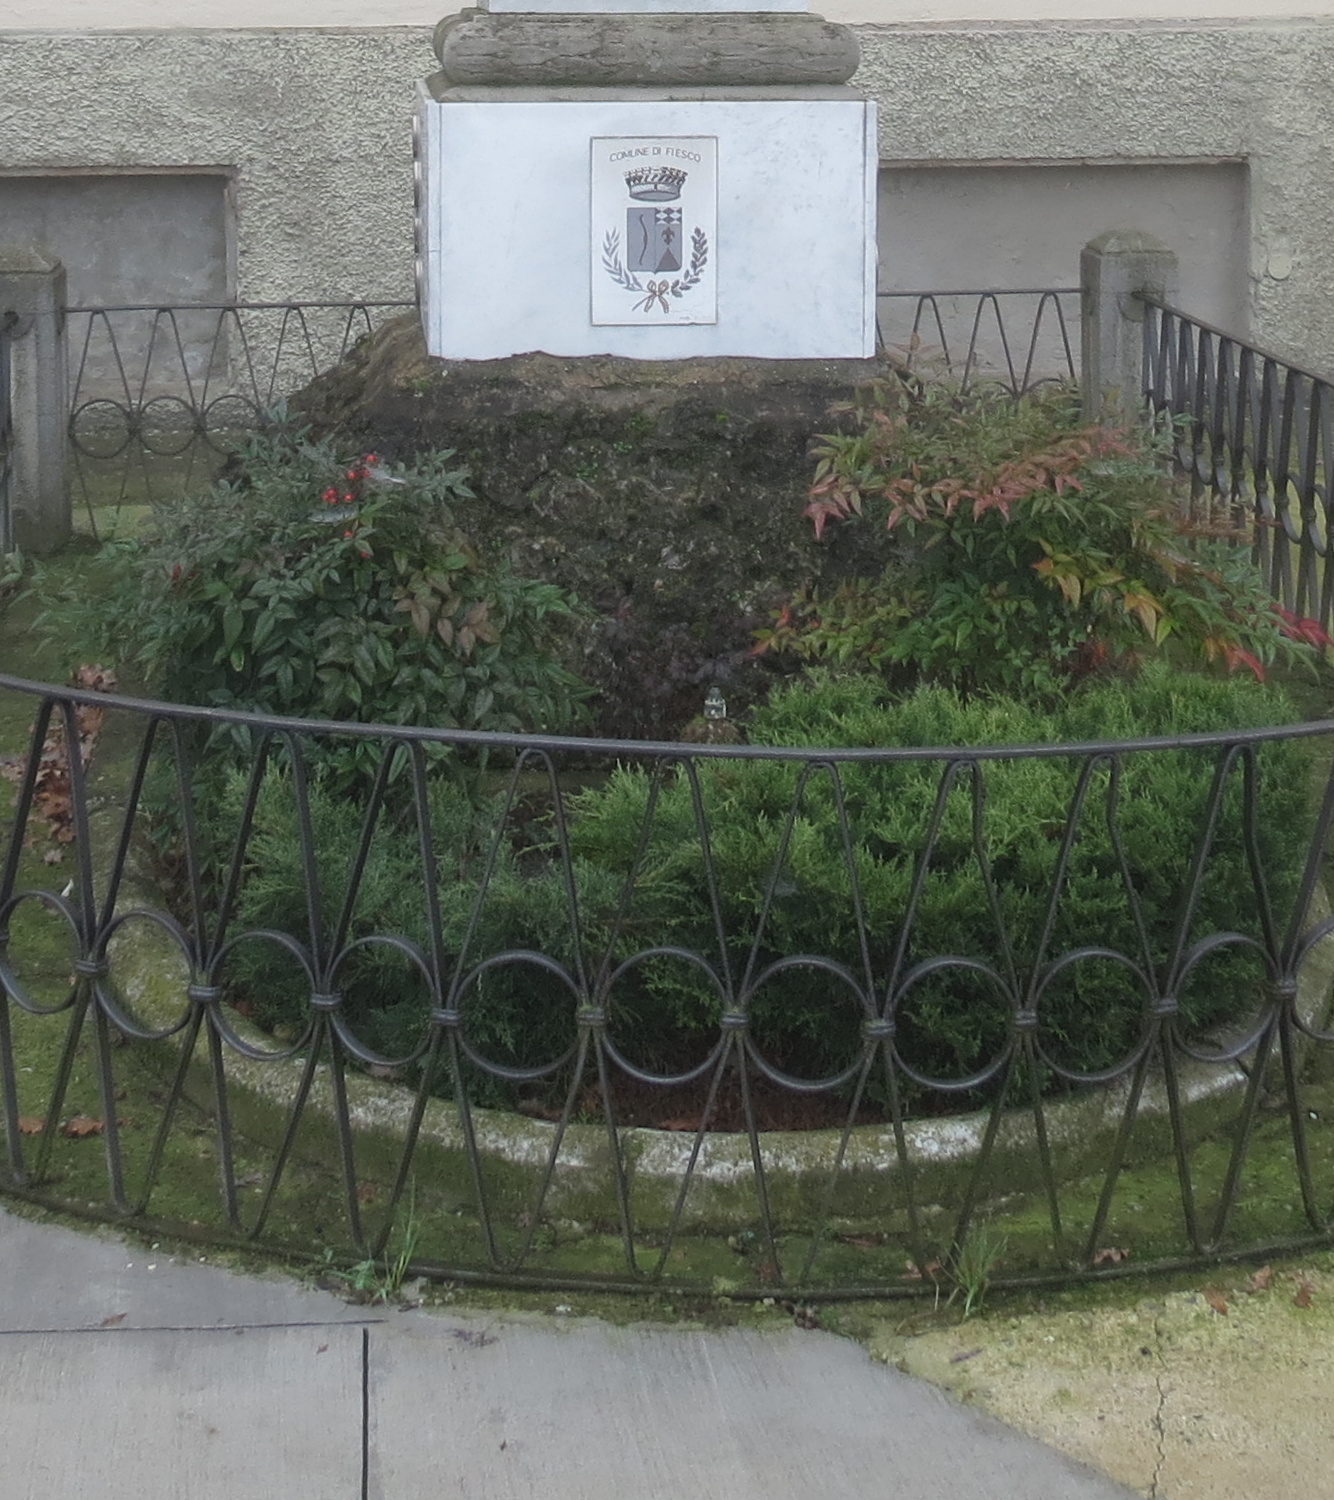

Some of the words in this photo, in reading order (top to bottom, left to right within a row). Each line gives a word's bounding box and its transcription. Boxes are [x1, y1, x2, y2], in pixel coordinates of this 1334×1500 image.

[610, 148, 648, 162] COMUNE
[653, 147, 661, 155] DI
[666, 147, 701, 163] FIESCO
